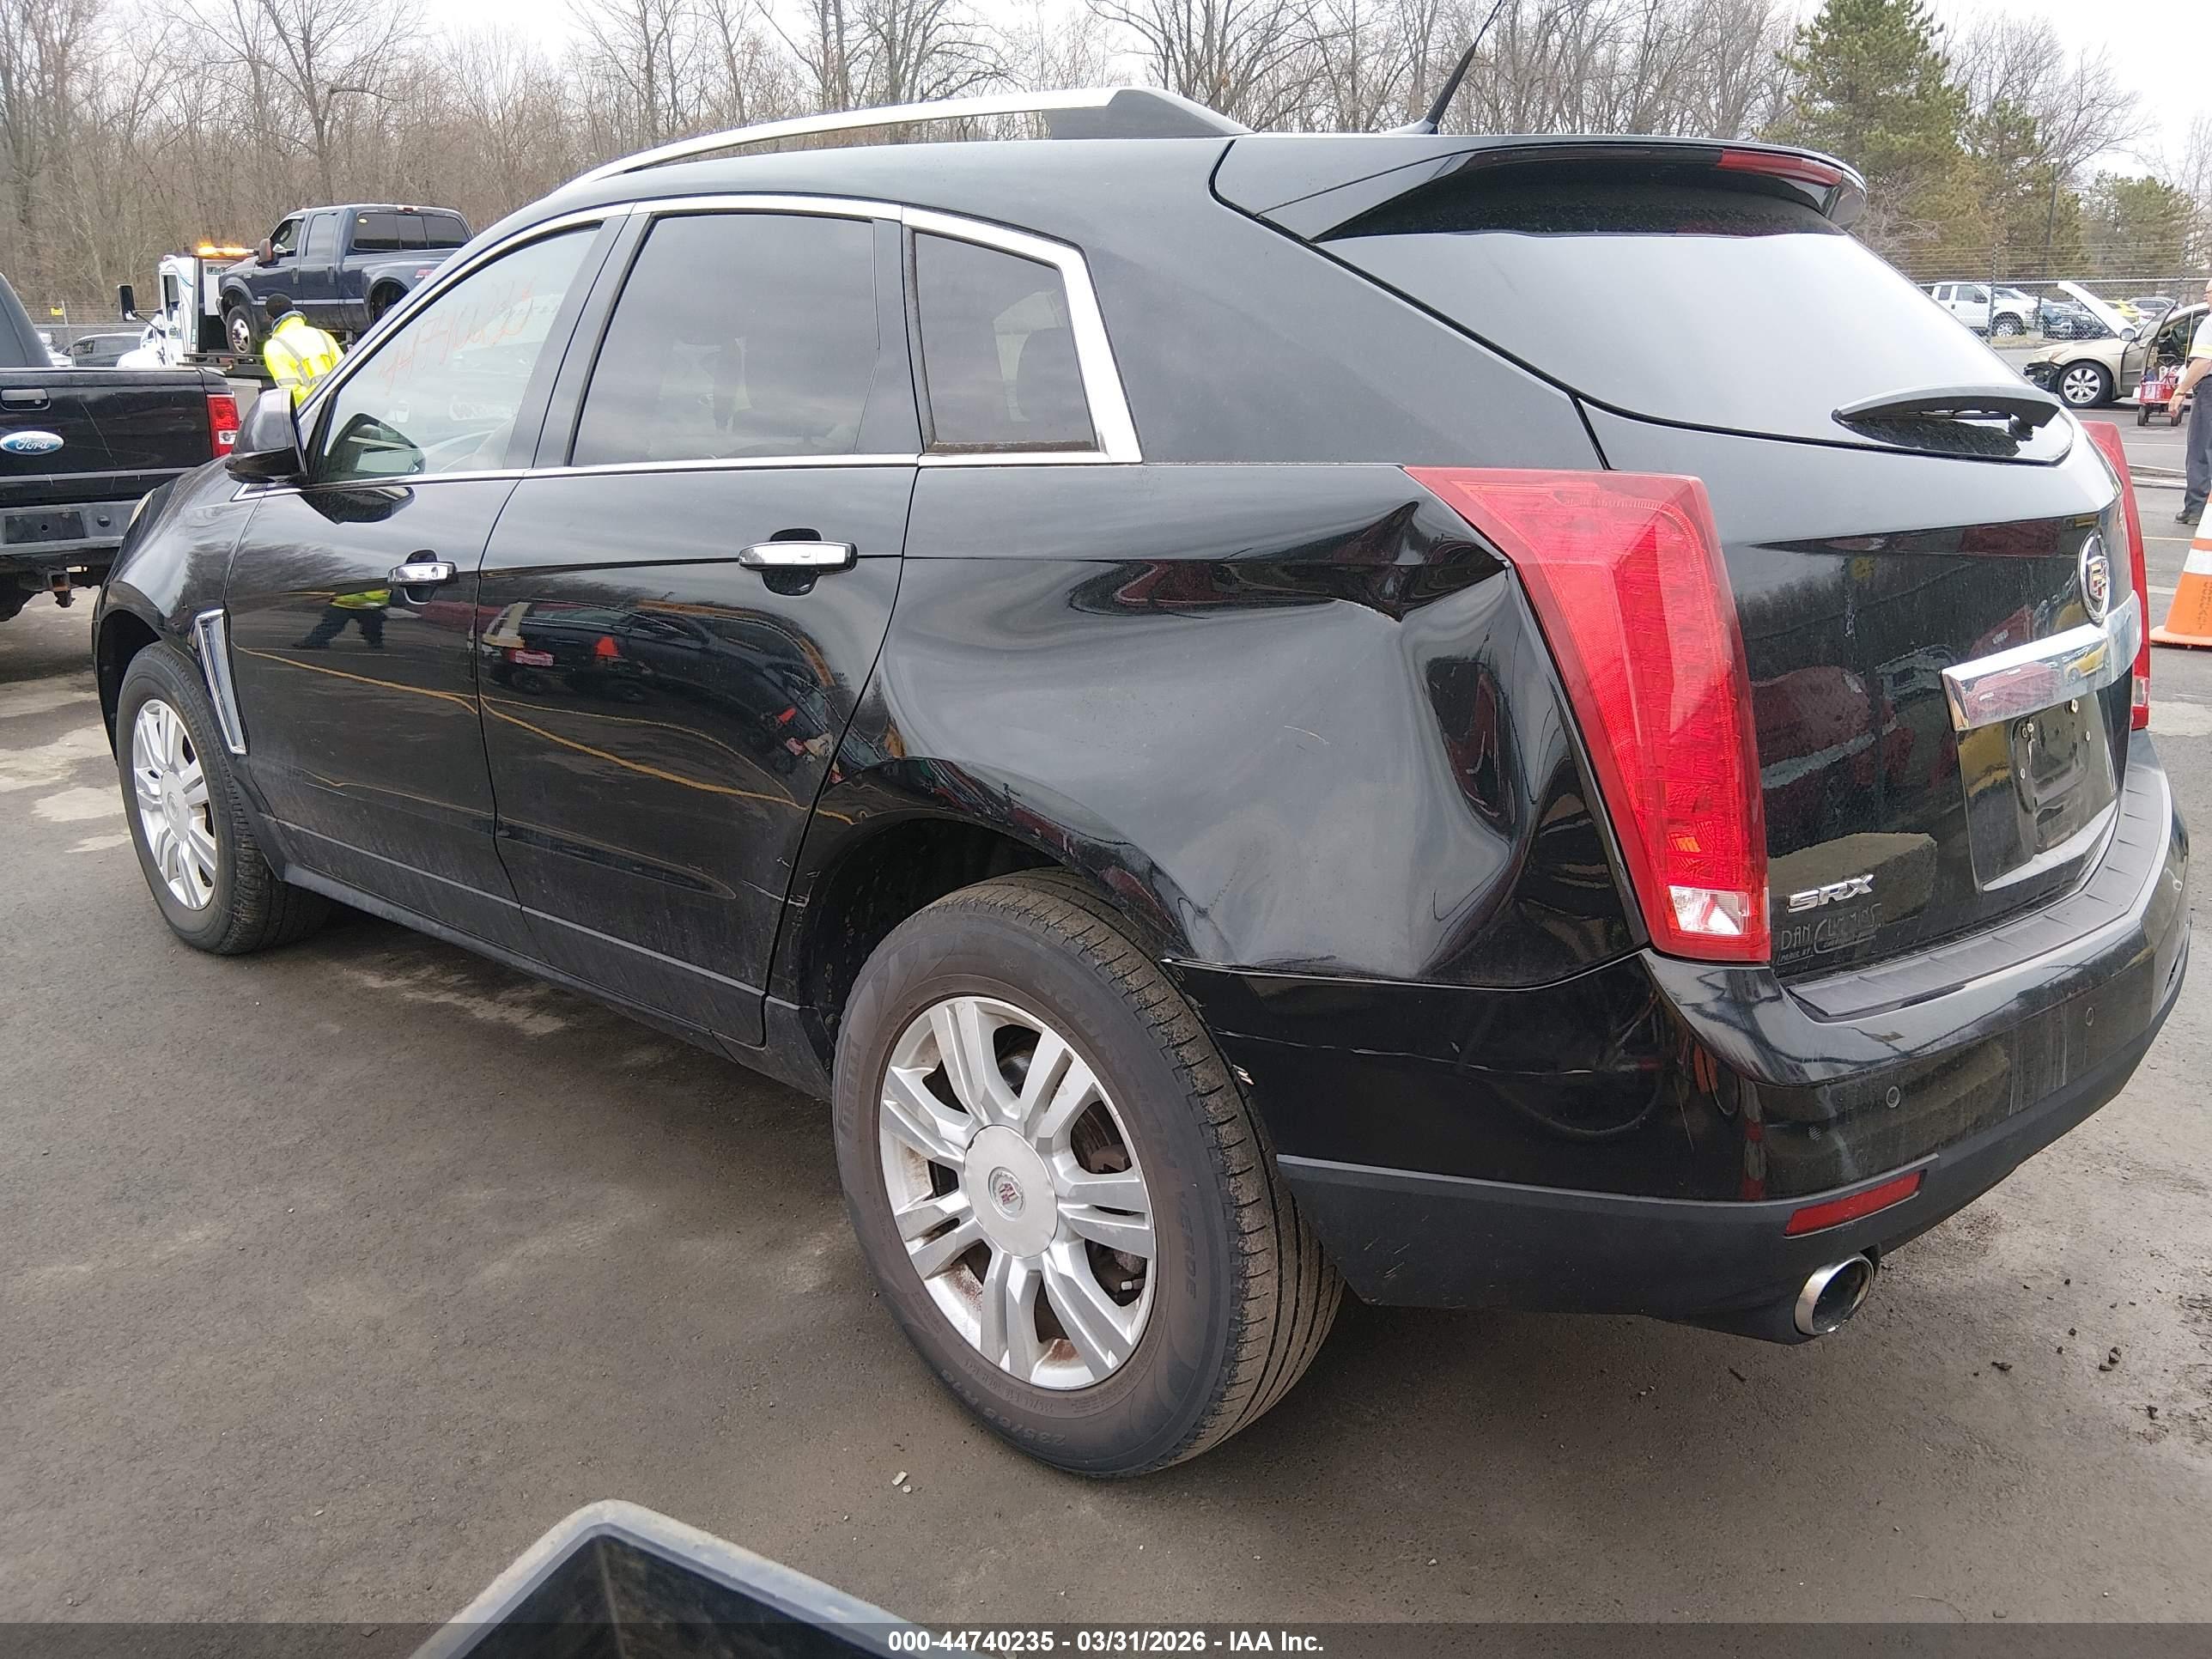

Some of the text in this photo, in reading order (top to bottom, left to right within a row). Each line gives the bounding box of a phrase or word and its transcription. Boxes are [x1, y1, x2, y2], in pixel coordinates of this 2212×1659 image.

[15, 436, 50, 450] Ford
[1787, 873, 1875, 914] SRX
[1781, 924, 1812, 950] DAN
[837, 1033, 862, 1139] PIRELLI
[1173, 1190, 1197, 1300] VERDE
